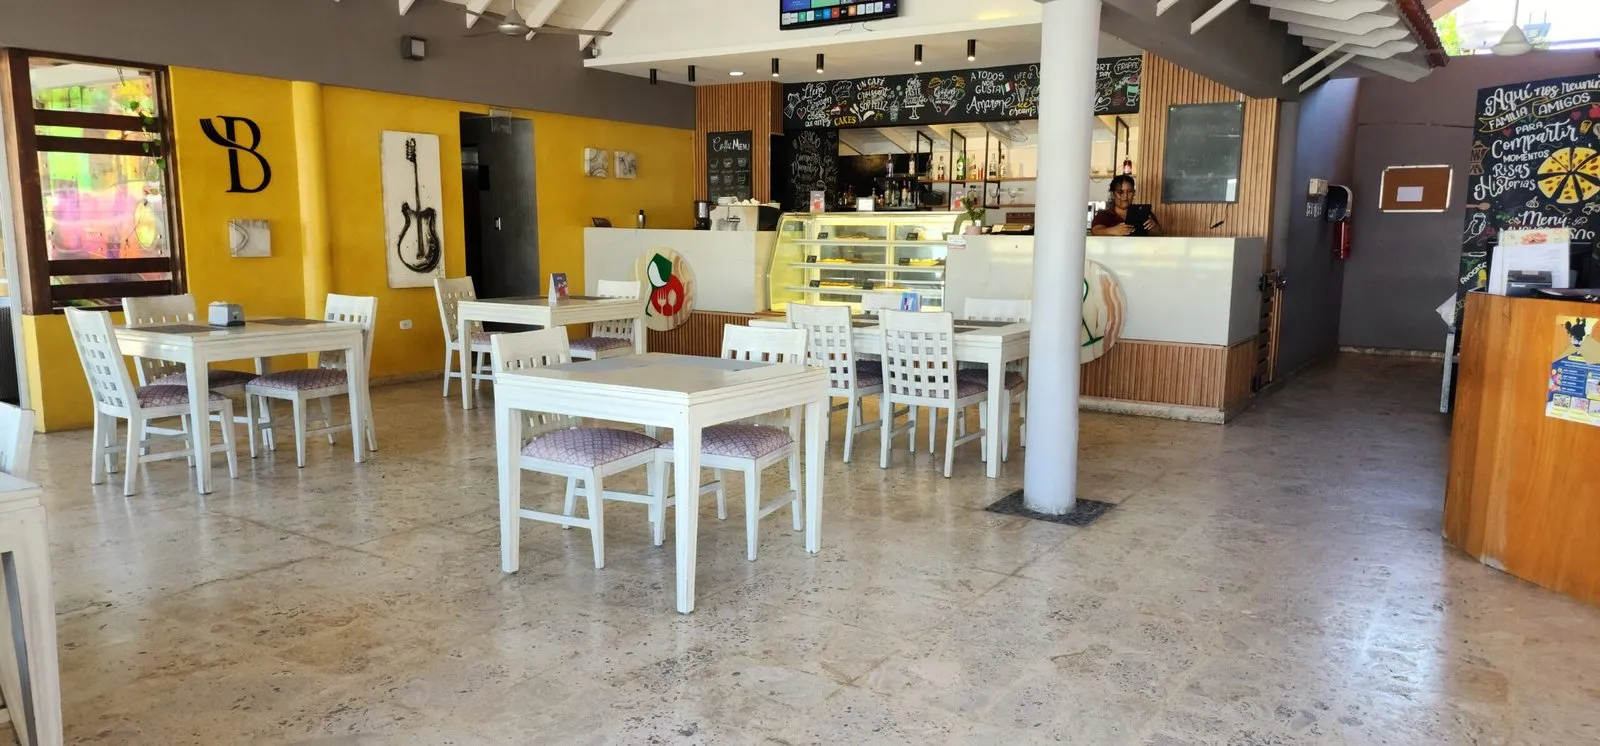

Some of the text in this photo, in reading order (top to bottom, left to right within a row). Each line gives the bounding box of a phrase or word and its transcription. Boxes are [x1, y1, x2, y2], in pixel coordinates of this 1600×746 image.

[977, 70, 1005, 81] TODOS
[857, 79, 867, 91] UN
[868, 77, 885, 87] CAFÉ
[975, 84, 1002, 95] GUSTA
[1483, 83, 1533, 117] Aquí
[1534, 85, 1559, 98] nos
[1489, 92, 1591, 130] FAMILIA AMIGOS
[834, 116, 857, 126] CAKES
[1515, 121, 1543, 135] PARA
[1492, 118, 1578, 159] Compartir
[1503, 149, 1550, 163] MOMENTOS
[1474, 174, 1537, 200] Historias
